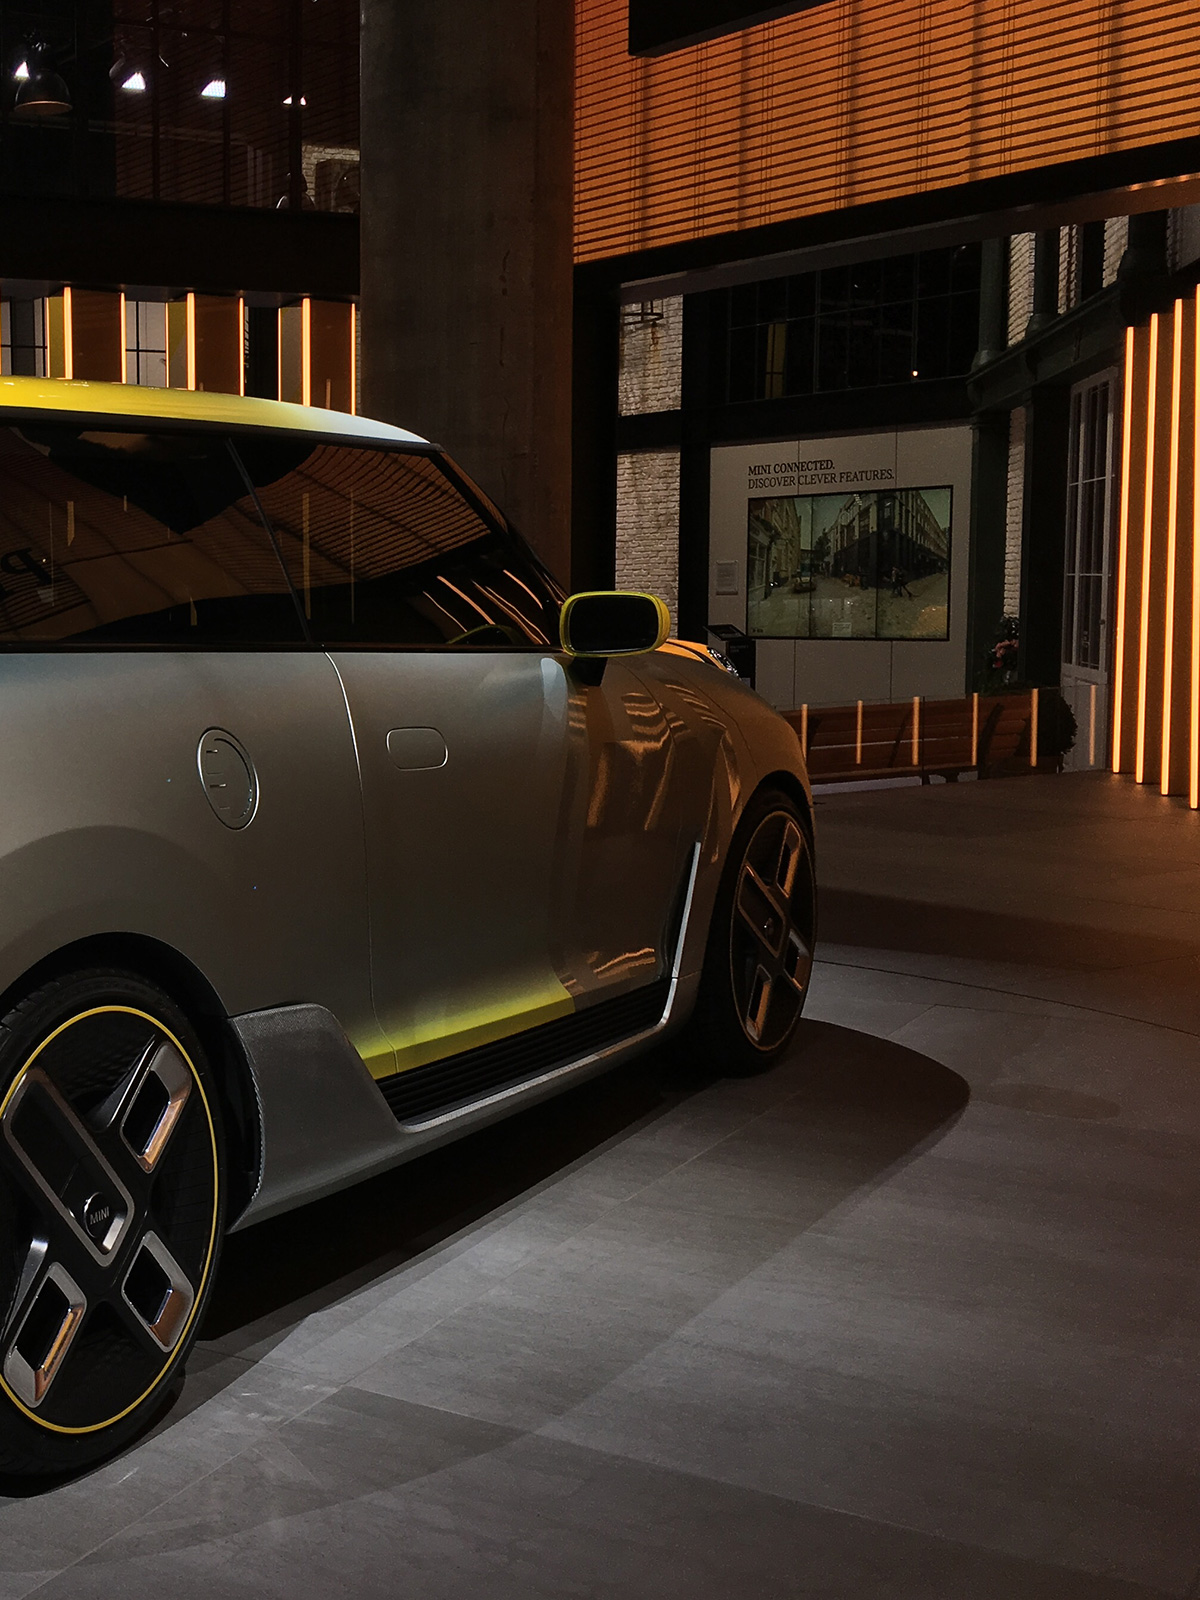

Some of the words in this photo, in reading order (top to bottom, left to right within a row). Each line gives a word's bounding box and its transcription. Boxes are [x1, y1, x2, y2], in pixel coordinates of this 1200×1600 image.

[747, 464, 771, 476] MINI
[773, 460, 835, 474] CONNECTED.
[747, 476, 796, 490] DISCOVER
[797, 473, 838, 486] CLEVER
[839, 469, 895, 483] FEATURES.
[89, 1206, 110, 1225] MINI
